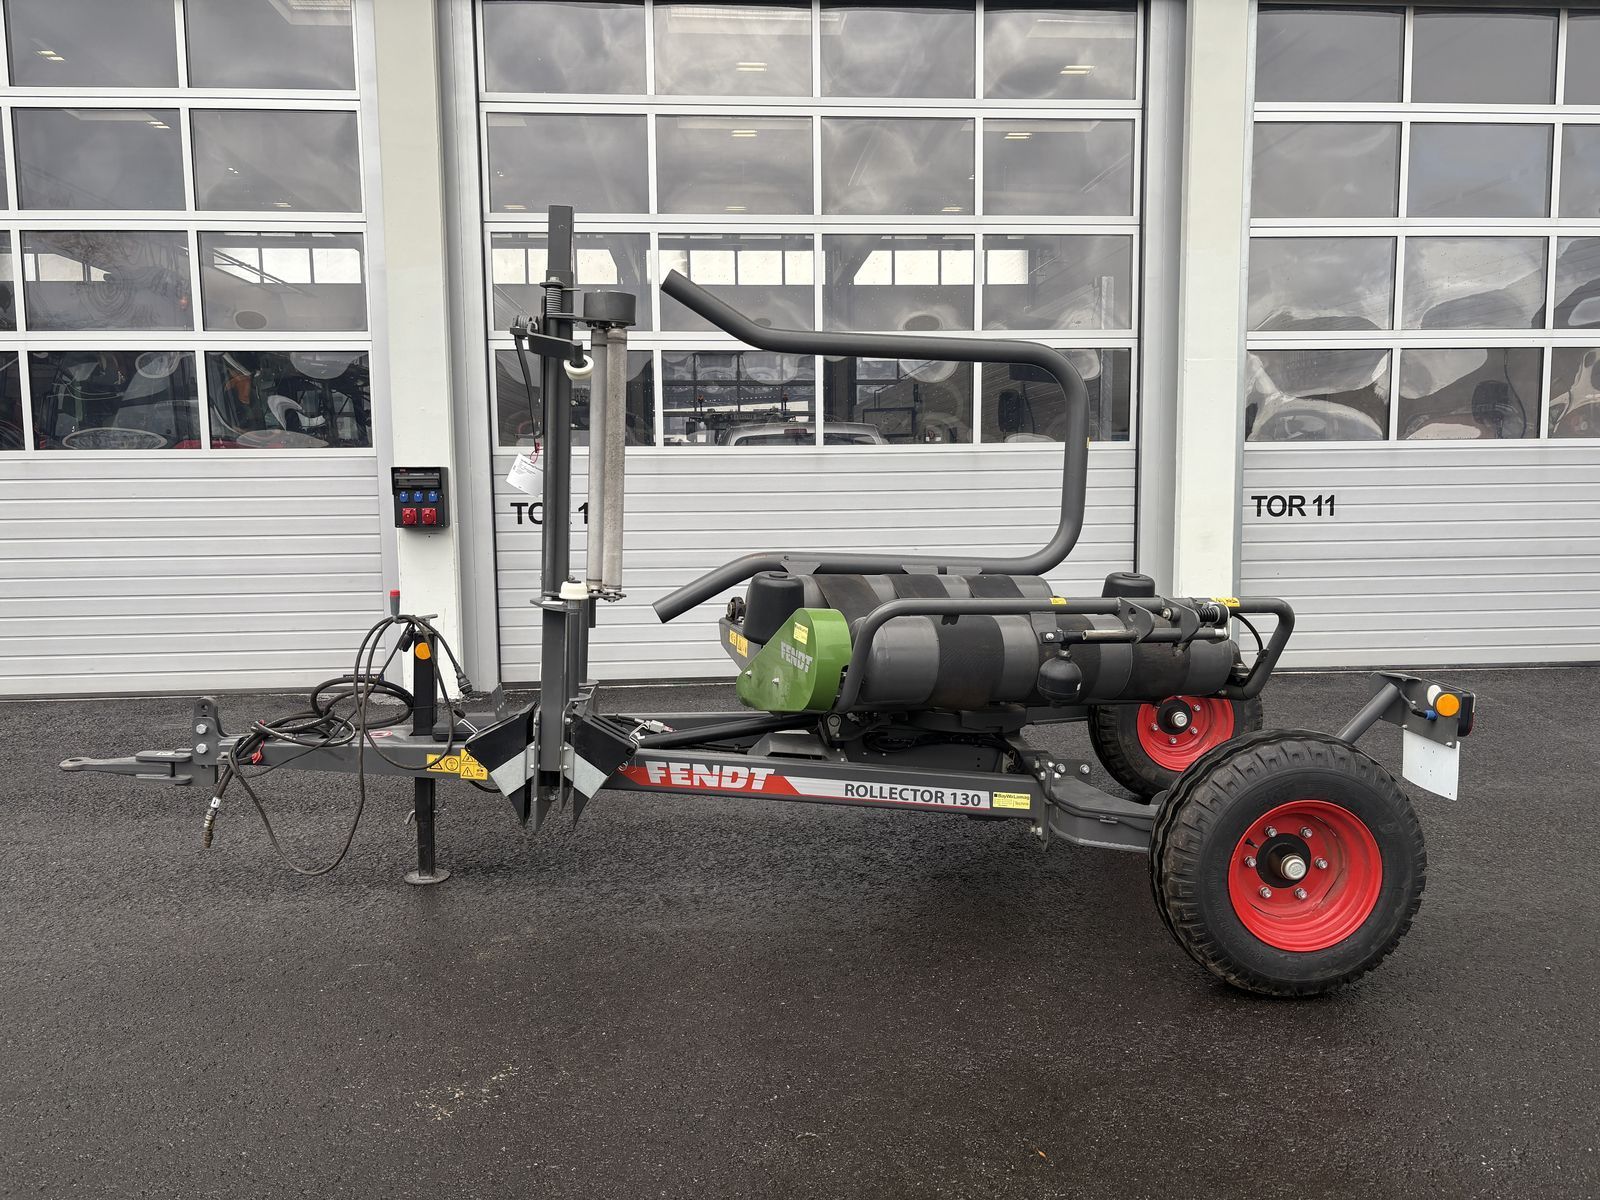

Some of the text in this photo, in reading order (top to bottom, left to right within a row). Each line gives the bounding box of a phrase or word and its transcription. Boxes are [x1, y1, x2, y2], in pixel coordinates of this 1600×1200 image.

[1251, 494, 1335, 517] TOR 11
[780, 641, 813, 673] FENDT
[645, 761, 775, 790] FENDT
[844, 783, 981, 807] ROLLECTOR 130
